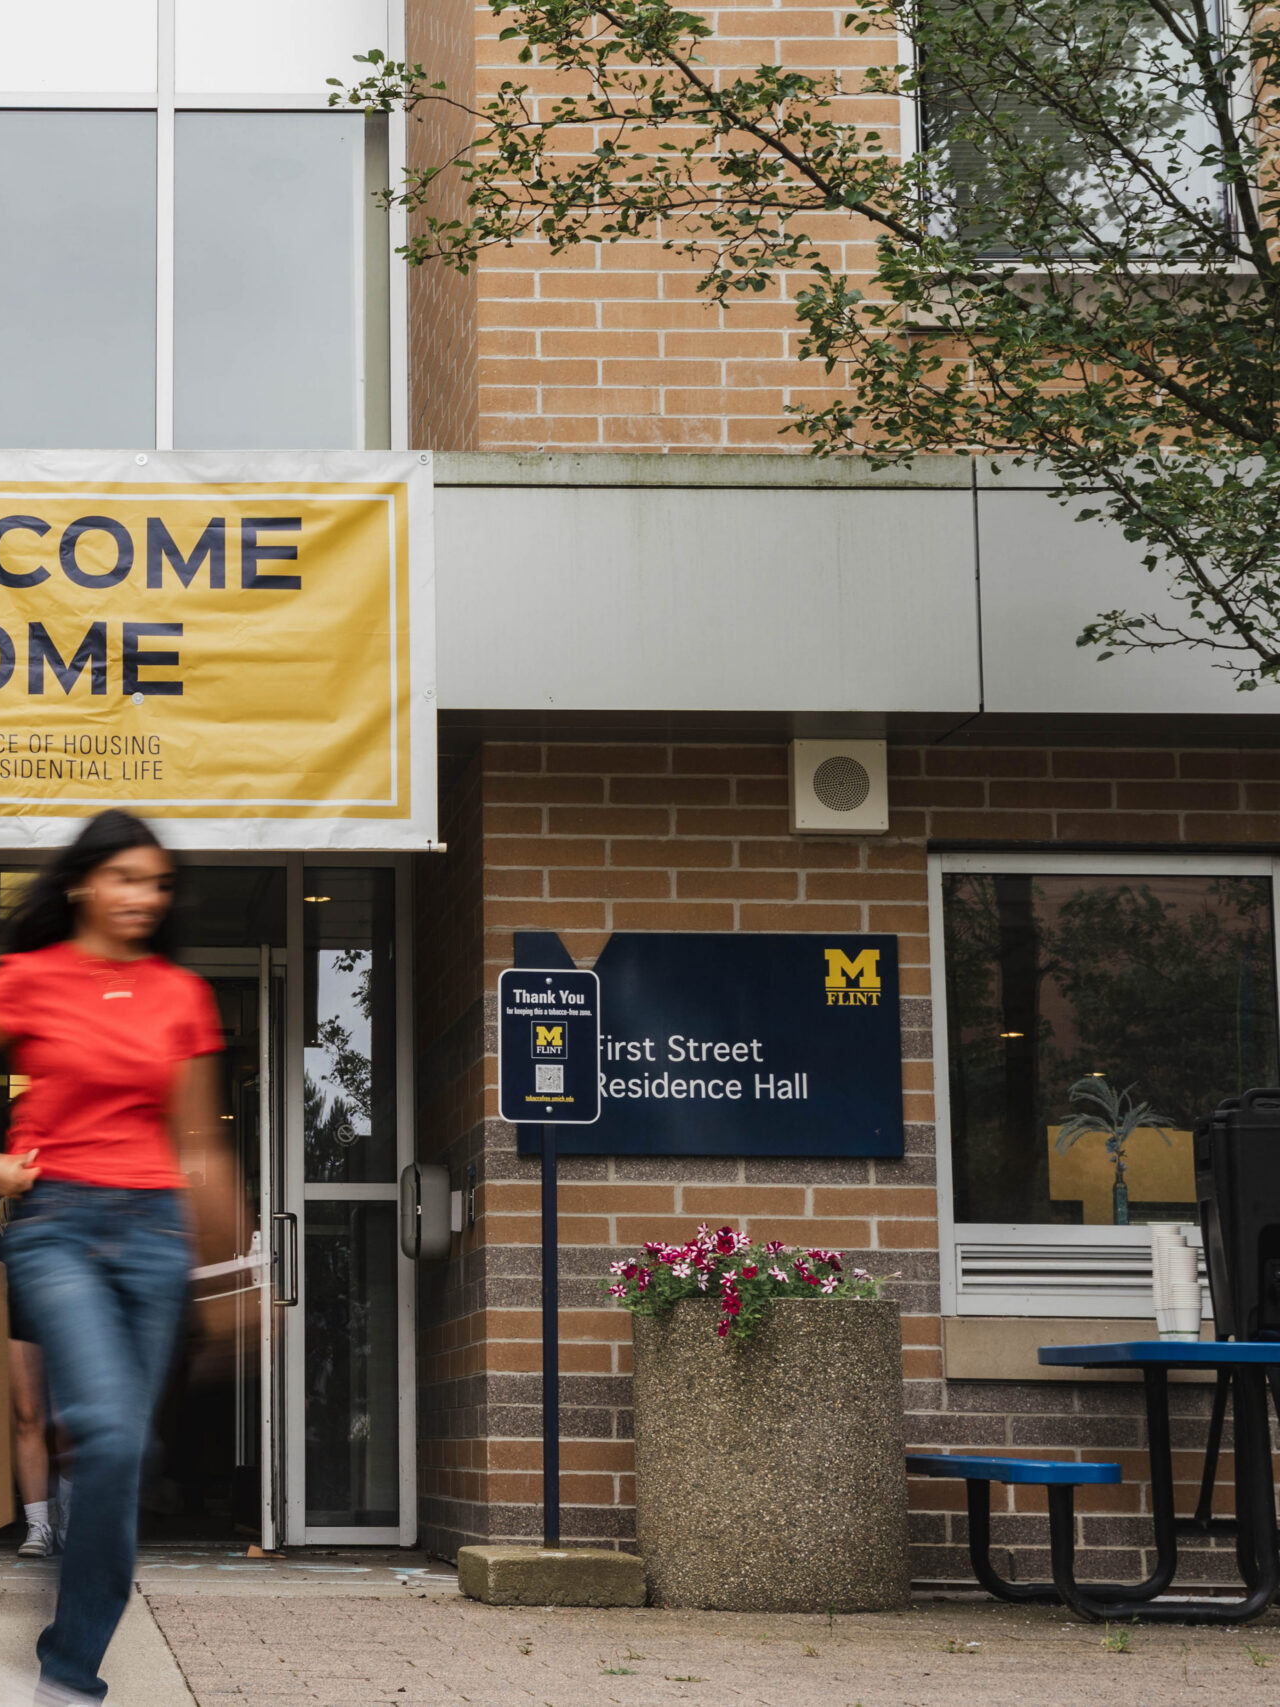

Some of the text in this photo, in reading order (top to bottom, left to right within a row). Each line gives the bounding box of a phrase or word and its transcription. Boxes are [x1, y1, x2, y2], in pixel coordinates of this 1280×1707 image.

[28, 734, 54, 754] OF
[64, 734, 161, 756] HOUSING
[122, 761, 163, 780] LIFE
[824, 949, 881, 988] M
[512, 989, 585, 1004] Thank You
[826, 992, 881, 1006] FLINT
[514, 1007, 533, 1016] keeping
[548, 1008, 579, 1016] tobacco-free
[536, 1026, 563, 1046] M
[536, 1046, 563, 1054] FLINT
[600, 1034, 764, 1062] irst Street
[754, 1073, 808, 1099] Hall
